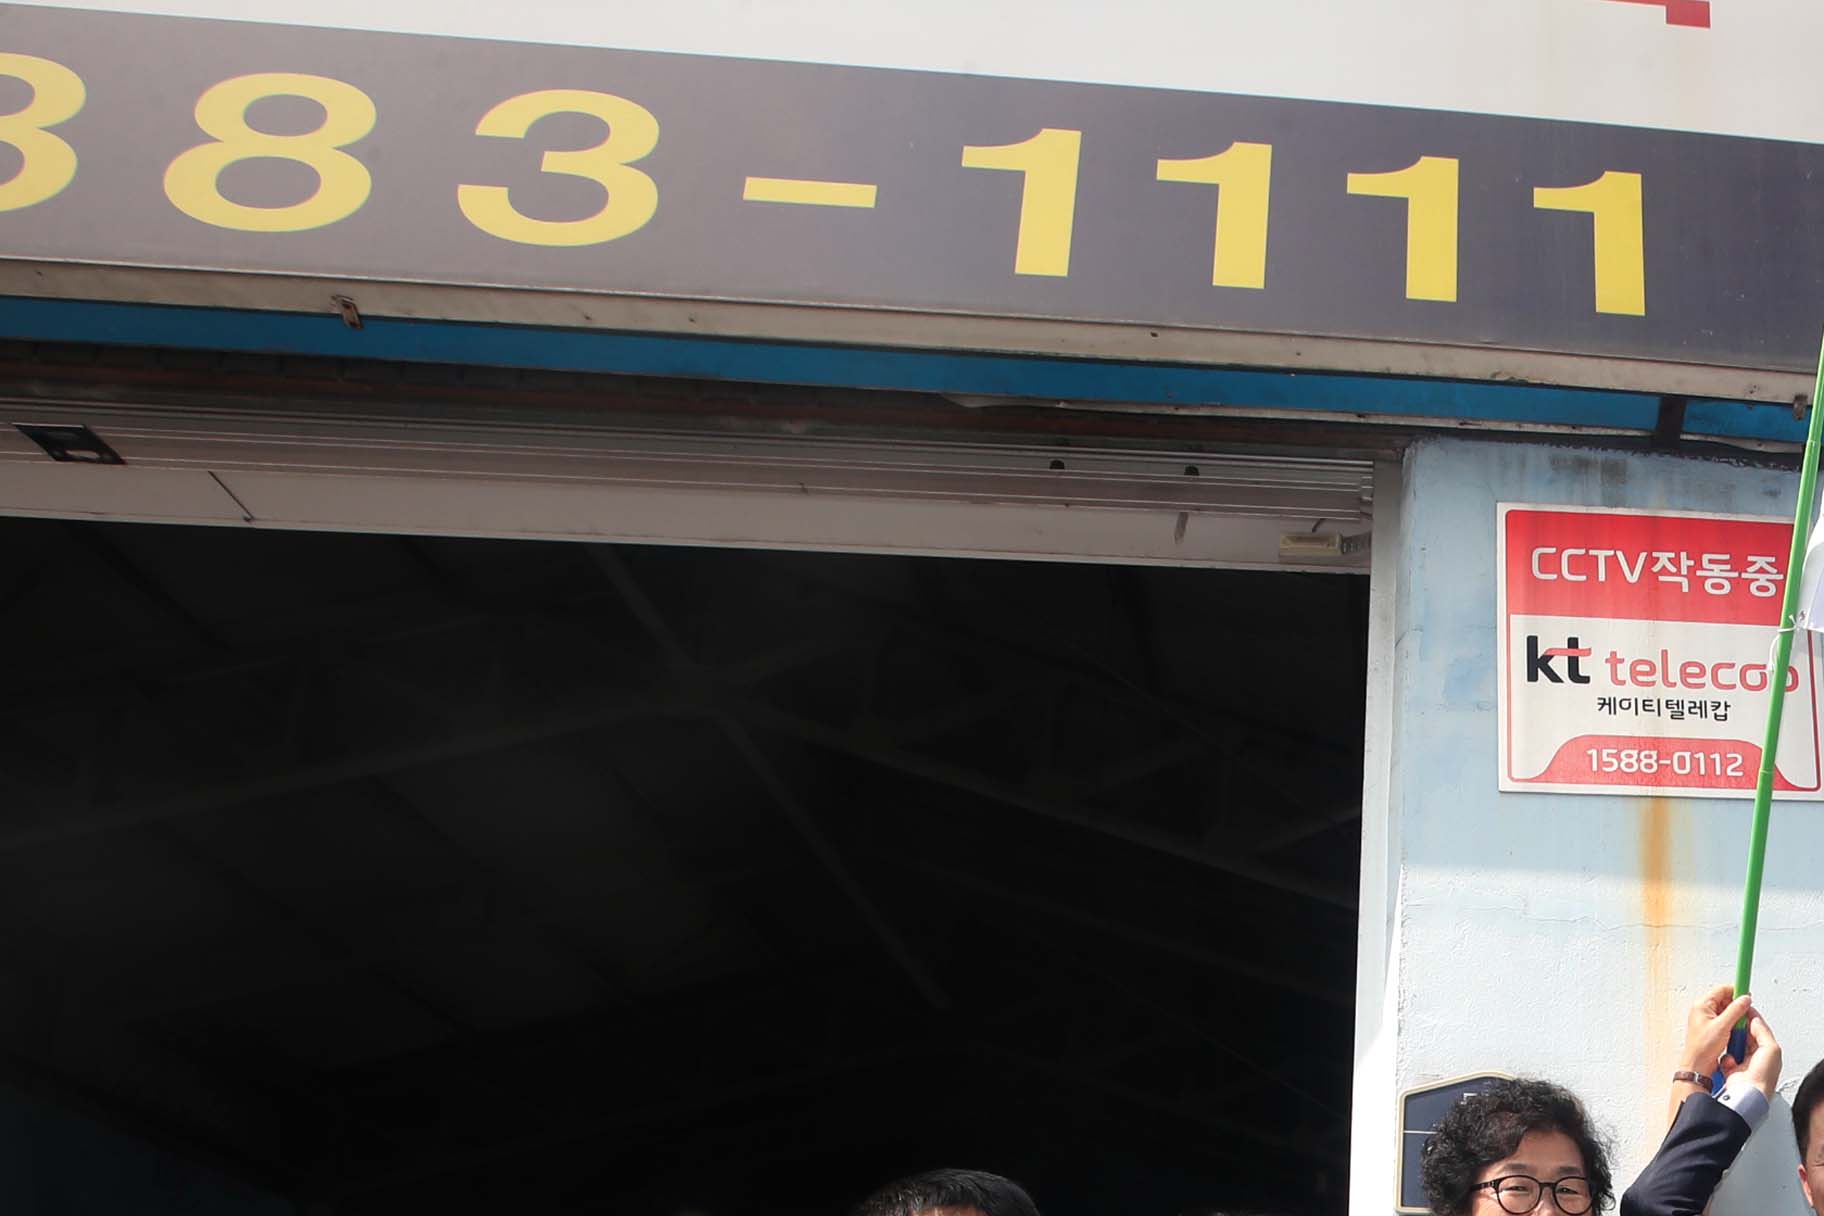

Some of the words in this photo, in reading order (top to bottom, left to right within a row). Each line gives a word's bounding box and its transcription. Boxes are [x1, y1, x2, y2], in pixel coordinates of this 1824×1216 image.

[1531, 547, 1784, 598] CCTV작동중
[1526, 635, 1592, 684] kt
[1597, 697, 1731, 721] 케이티텔레캅
[1586, 749, 1744, 777] 1588-0112
